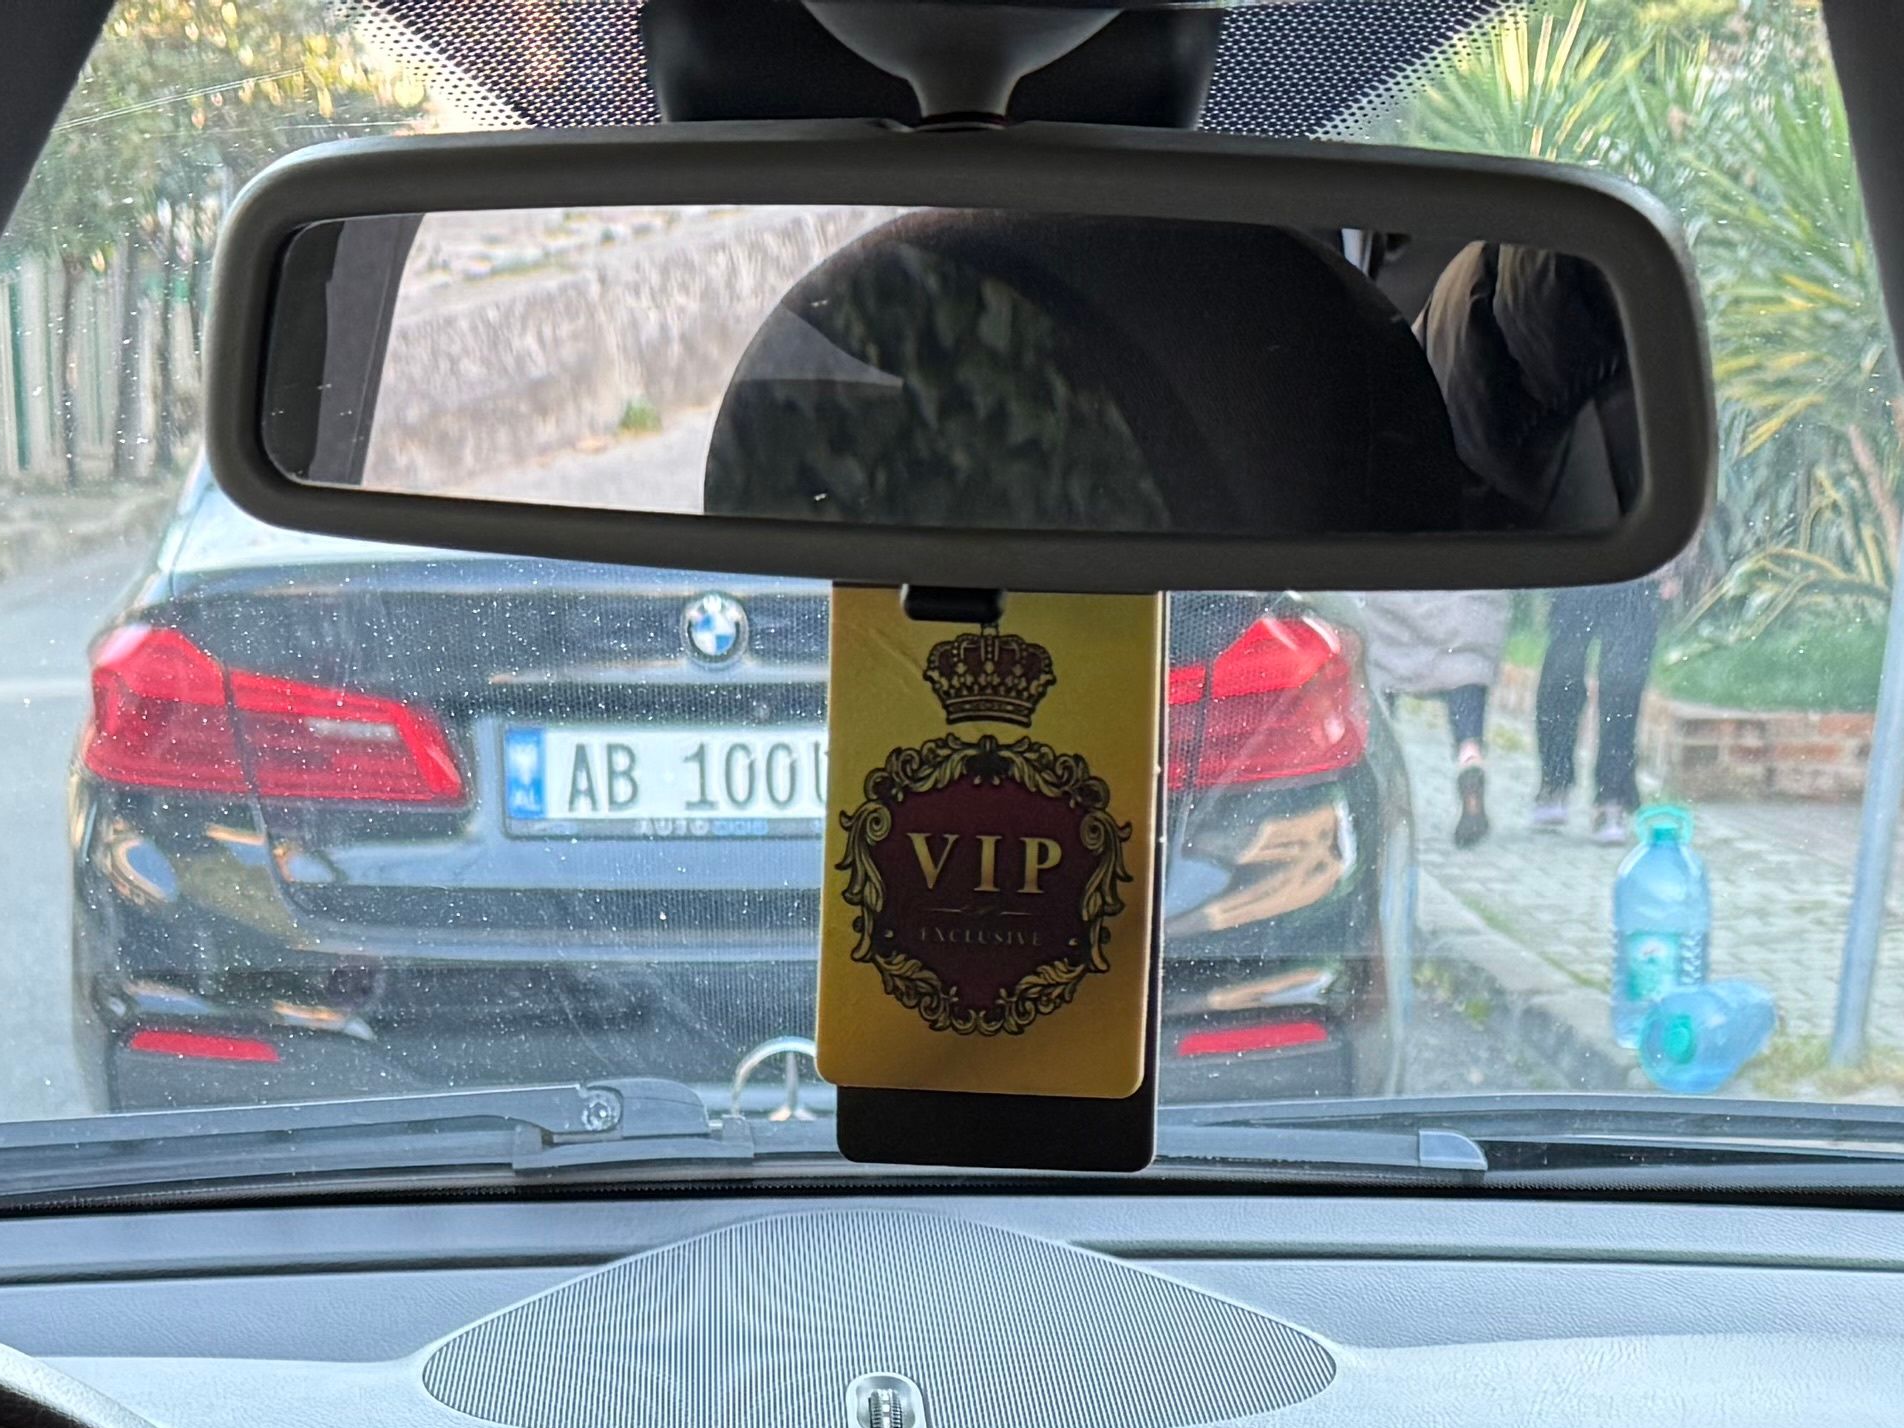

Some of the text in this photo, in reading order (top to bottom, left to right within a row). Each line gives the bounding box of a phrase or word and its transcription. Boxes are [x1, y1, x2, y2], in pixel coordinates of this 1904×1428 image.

[568, 743, 639, 812] AB
[905, 832, 1063, 894] VIP
[920, 927, 1043, 946] EXCLUSIVE
